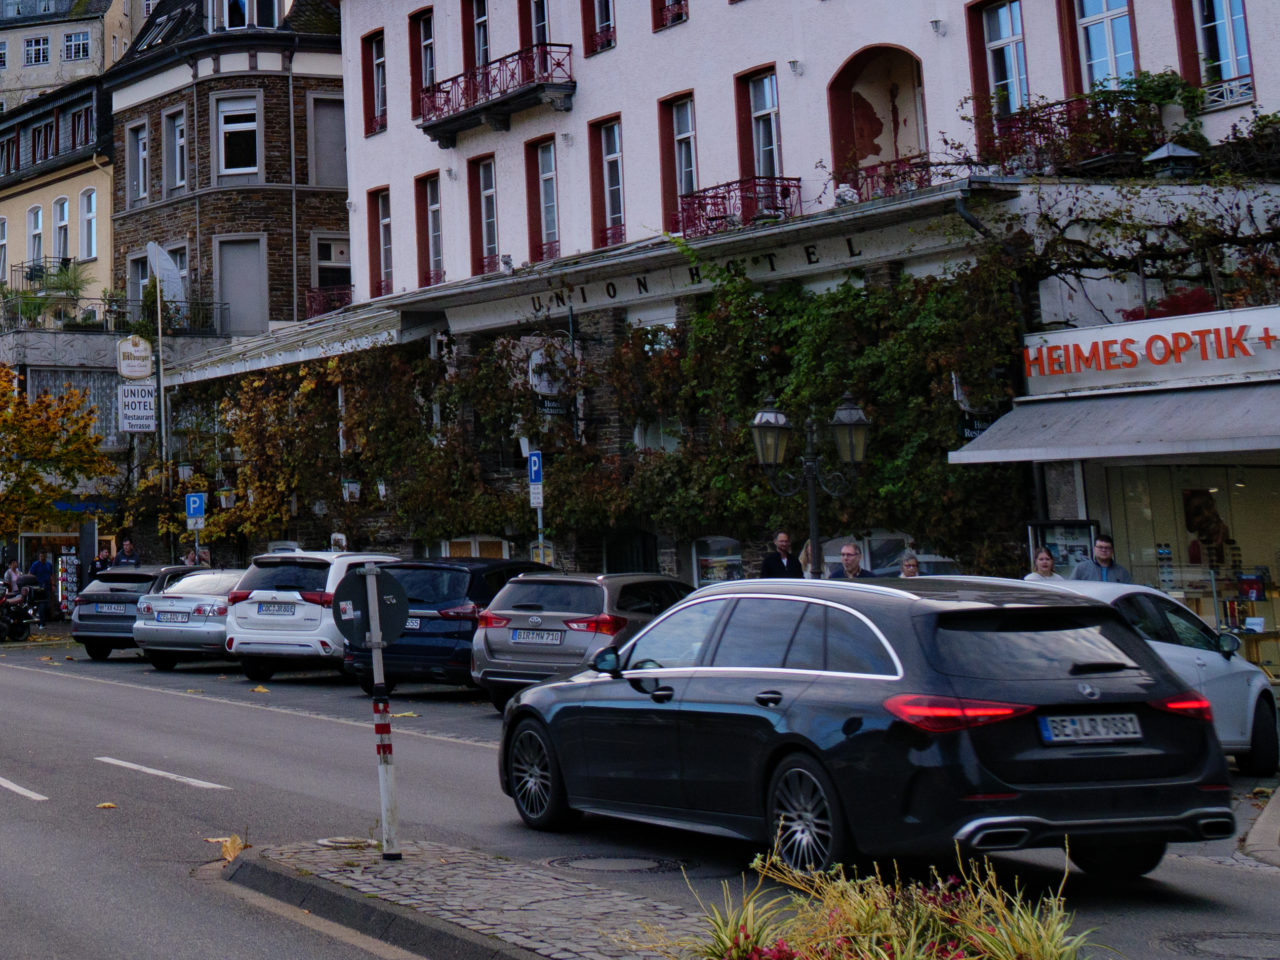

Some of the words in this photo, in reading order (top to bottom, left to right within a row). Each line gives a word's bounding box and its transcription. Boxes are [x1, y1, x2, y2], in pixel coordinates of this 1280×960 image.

[531, 276, 649, 313] UNION
[1023, 338, 1139, 377] HEIMES
[1145, 325, 1254, 365] OPTIK
[123, 388, 154, 399] UNION
[123, 400, 154, 411] HOTEL
[123, 412, 154, 421] Restaurant
[128, 421, 151, 430] Terrasse
[531, 456, 539, 480] P
[189, 497, 200, 514] P
[517, 631, 531, 640] BIR
[545, 632, 559, 641] 710
[1051, 719, 1071, 737] BE
